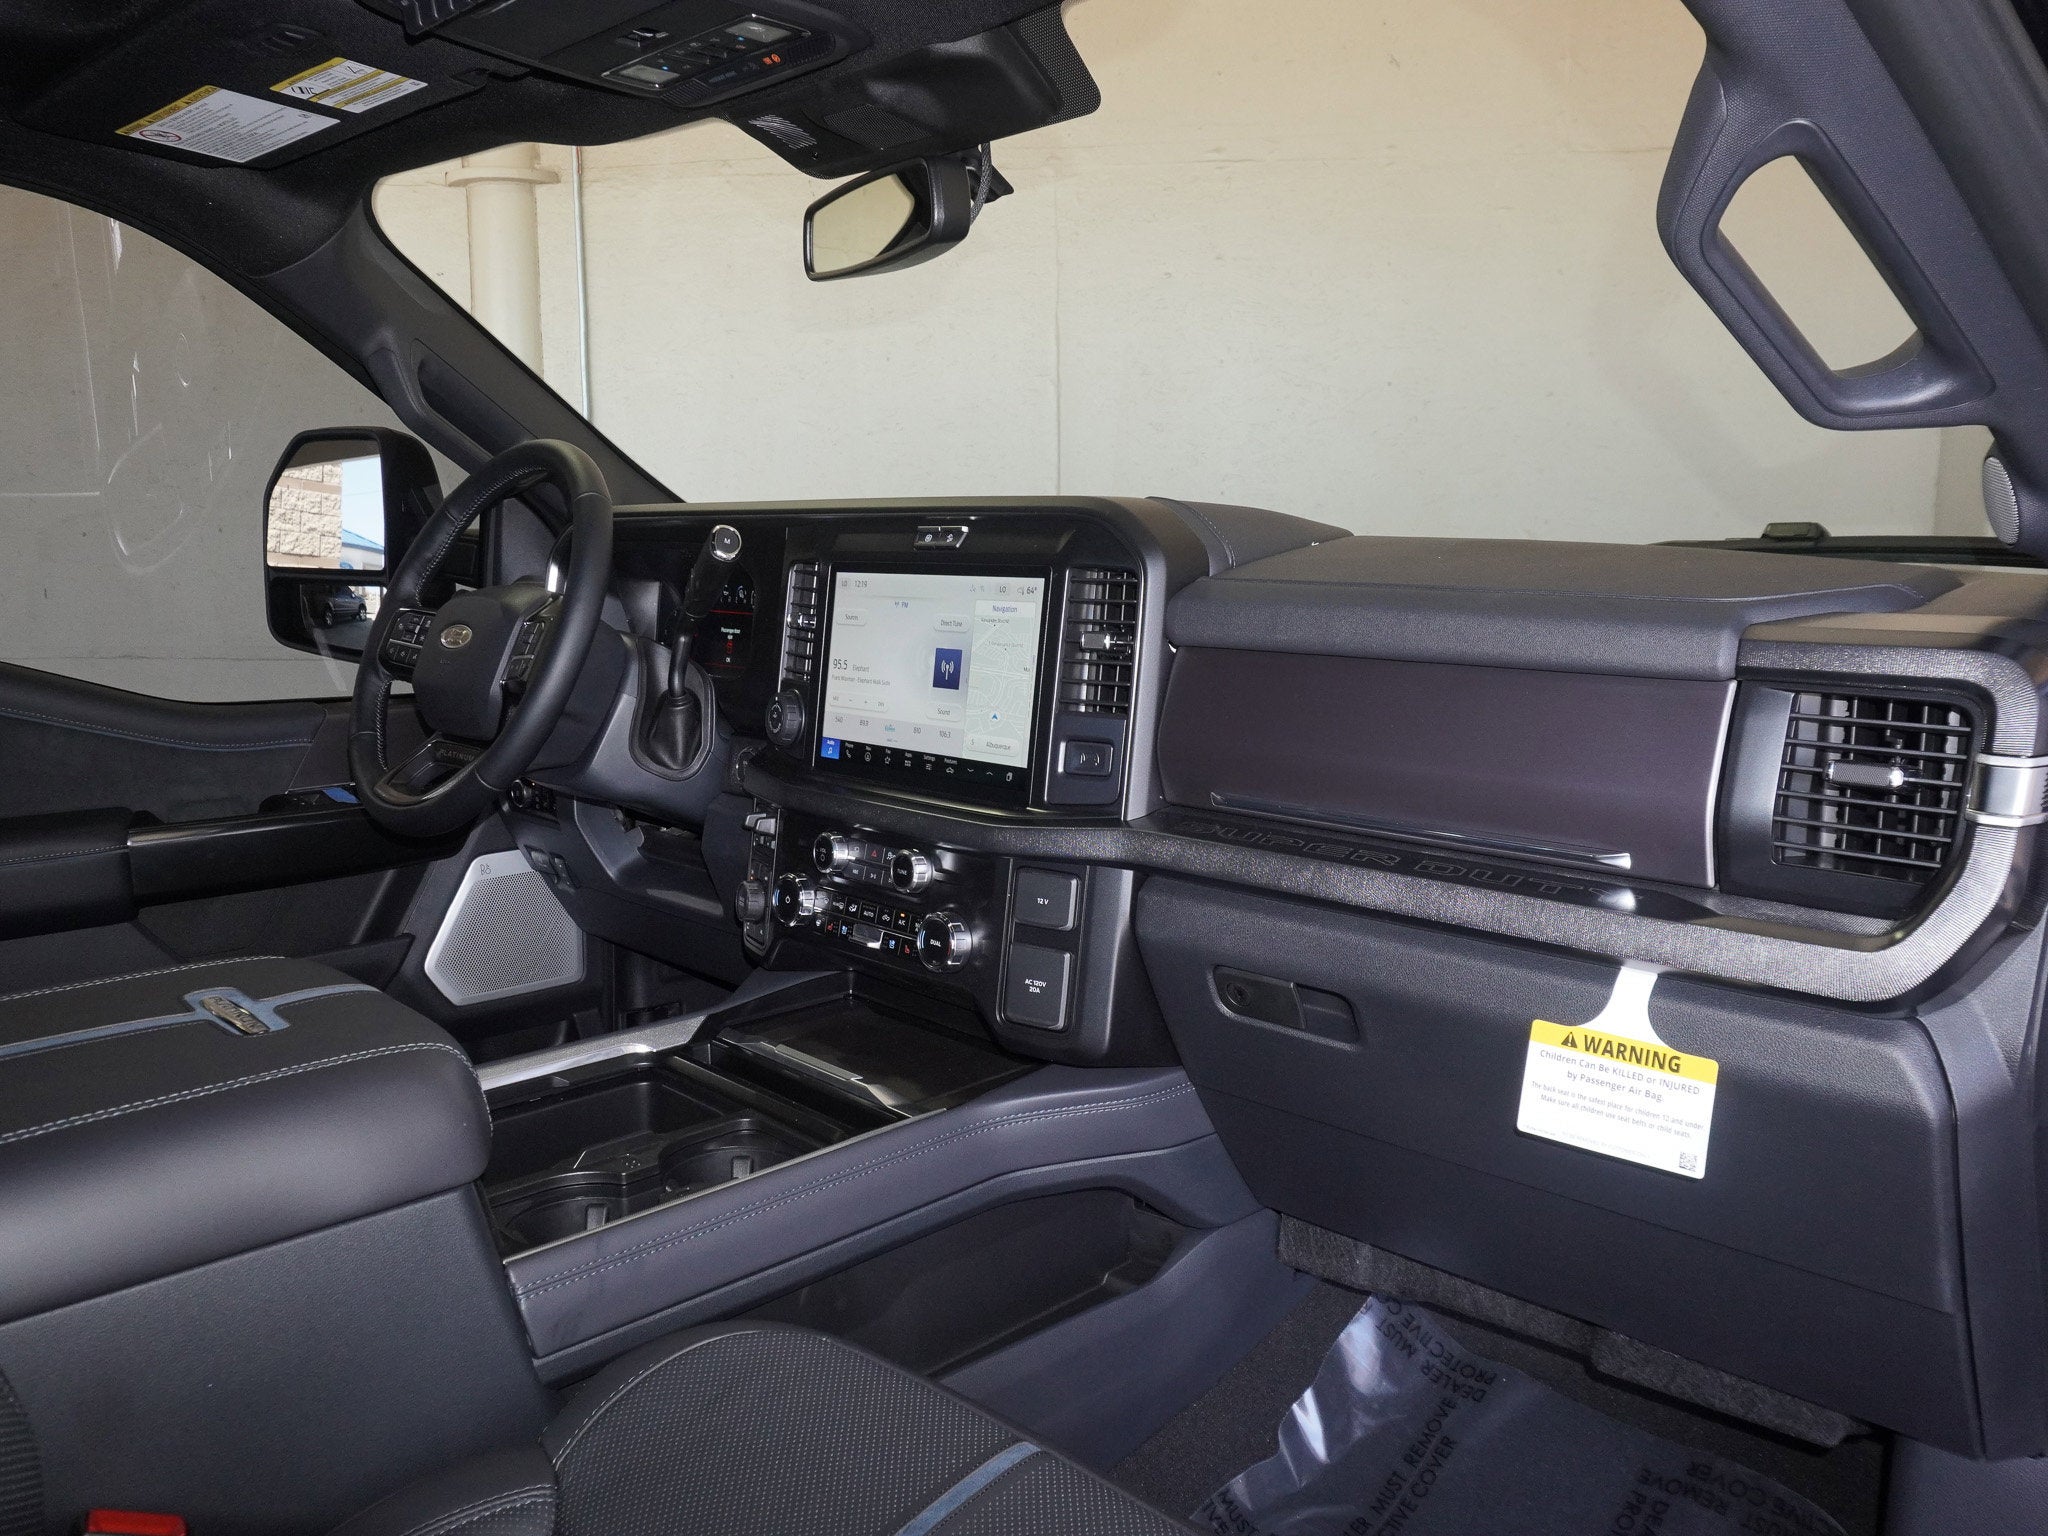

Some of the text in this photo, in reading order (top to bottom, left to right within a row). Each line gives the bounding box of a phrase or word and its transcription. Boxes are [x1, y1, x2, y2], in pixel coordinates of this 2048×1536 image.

[724, 537, 731, 545] M
[992, 604, 1018, 614] Navigation
[833, 658, 848, 670] 95.5
[937, 708, 950, 716] Sound
[1037, 897, 1044, 905] 12
[863, 910, 875, 918] AUTO
[929, 939, 941, 948] DUAL
[1025, 978, 1047, 988] AC 120V
[1029, 986, 1041, 994] 20A
[1582, 1033, 1681, 1074] WARNING
[1539, 1048, 1700, 1096] Children Can Be KILLED or INJURED
[1566, 1069, 1577, 1081] by
[1579, 1073, 1626, 1093] Passenger
[1627, 1085, 1642, 1096] Air
[1531, 1080, 1541, 1089] The
[1542, 1083, 1556, 1093] back
[1557, 1088, 1569, 1096] seat
[1577, 1092, 1587, 1101] the
[1588, 1095, 1605, 1106] safest
[1606, 1100, 1623, 1112] place
[1540, 1093, 1556, 1103] Make
[1557, 1099, 1570, 1107] sure
[1580, 1104, 1603, 1116] children
[1617, 1115, 1630, 1123] seat
[1402, 1311, 1498, 1386] PROTECTIVE
[1420, 1362, 1487, 1402] DEALER
[1370, 1397, 1459, 1516] MUST REMOVE
[1411, 1434, 1459, 1499] COVER
